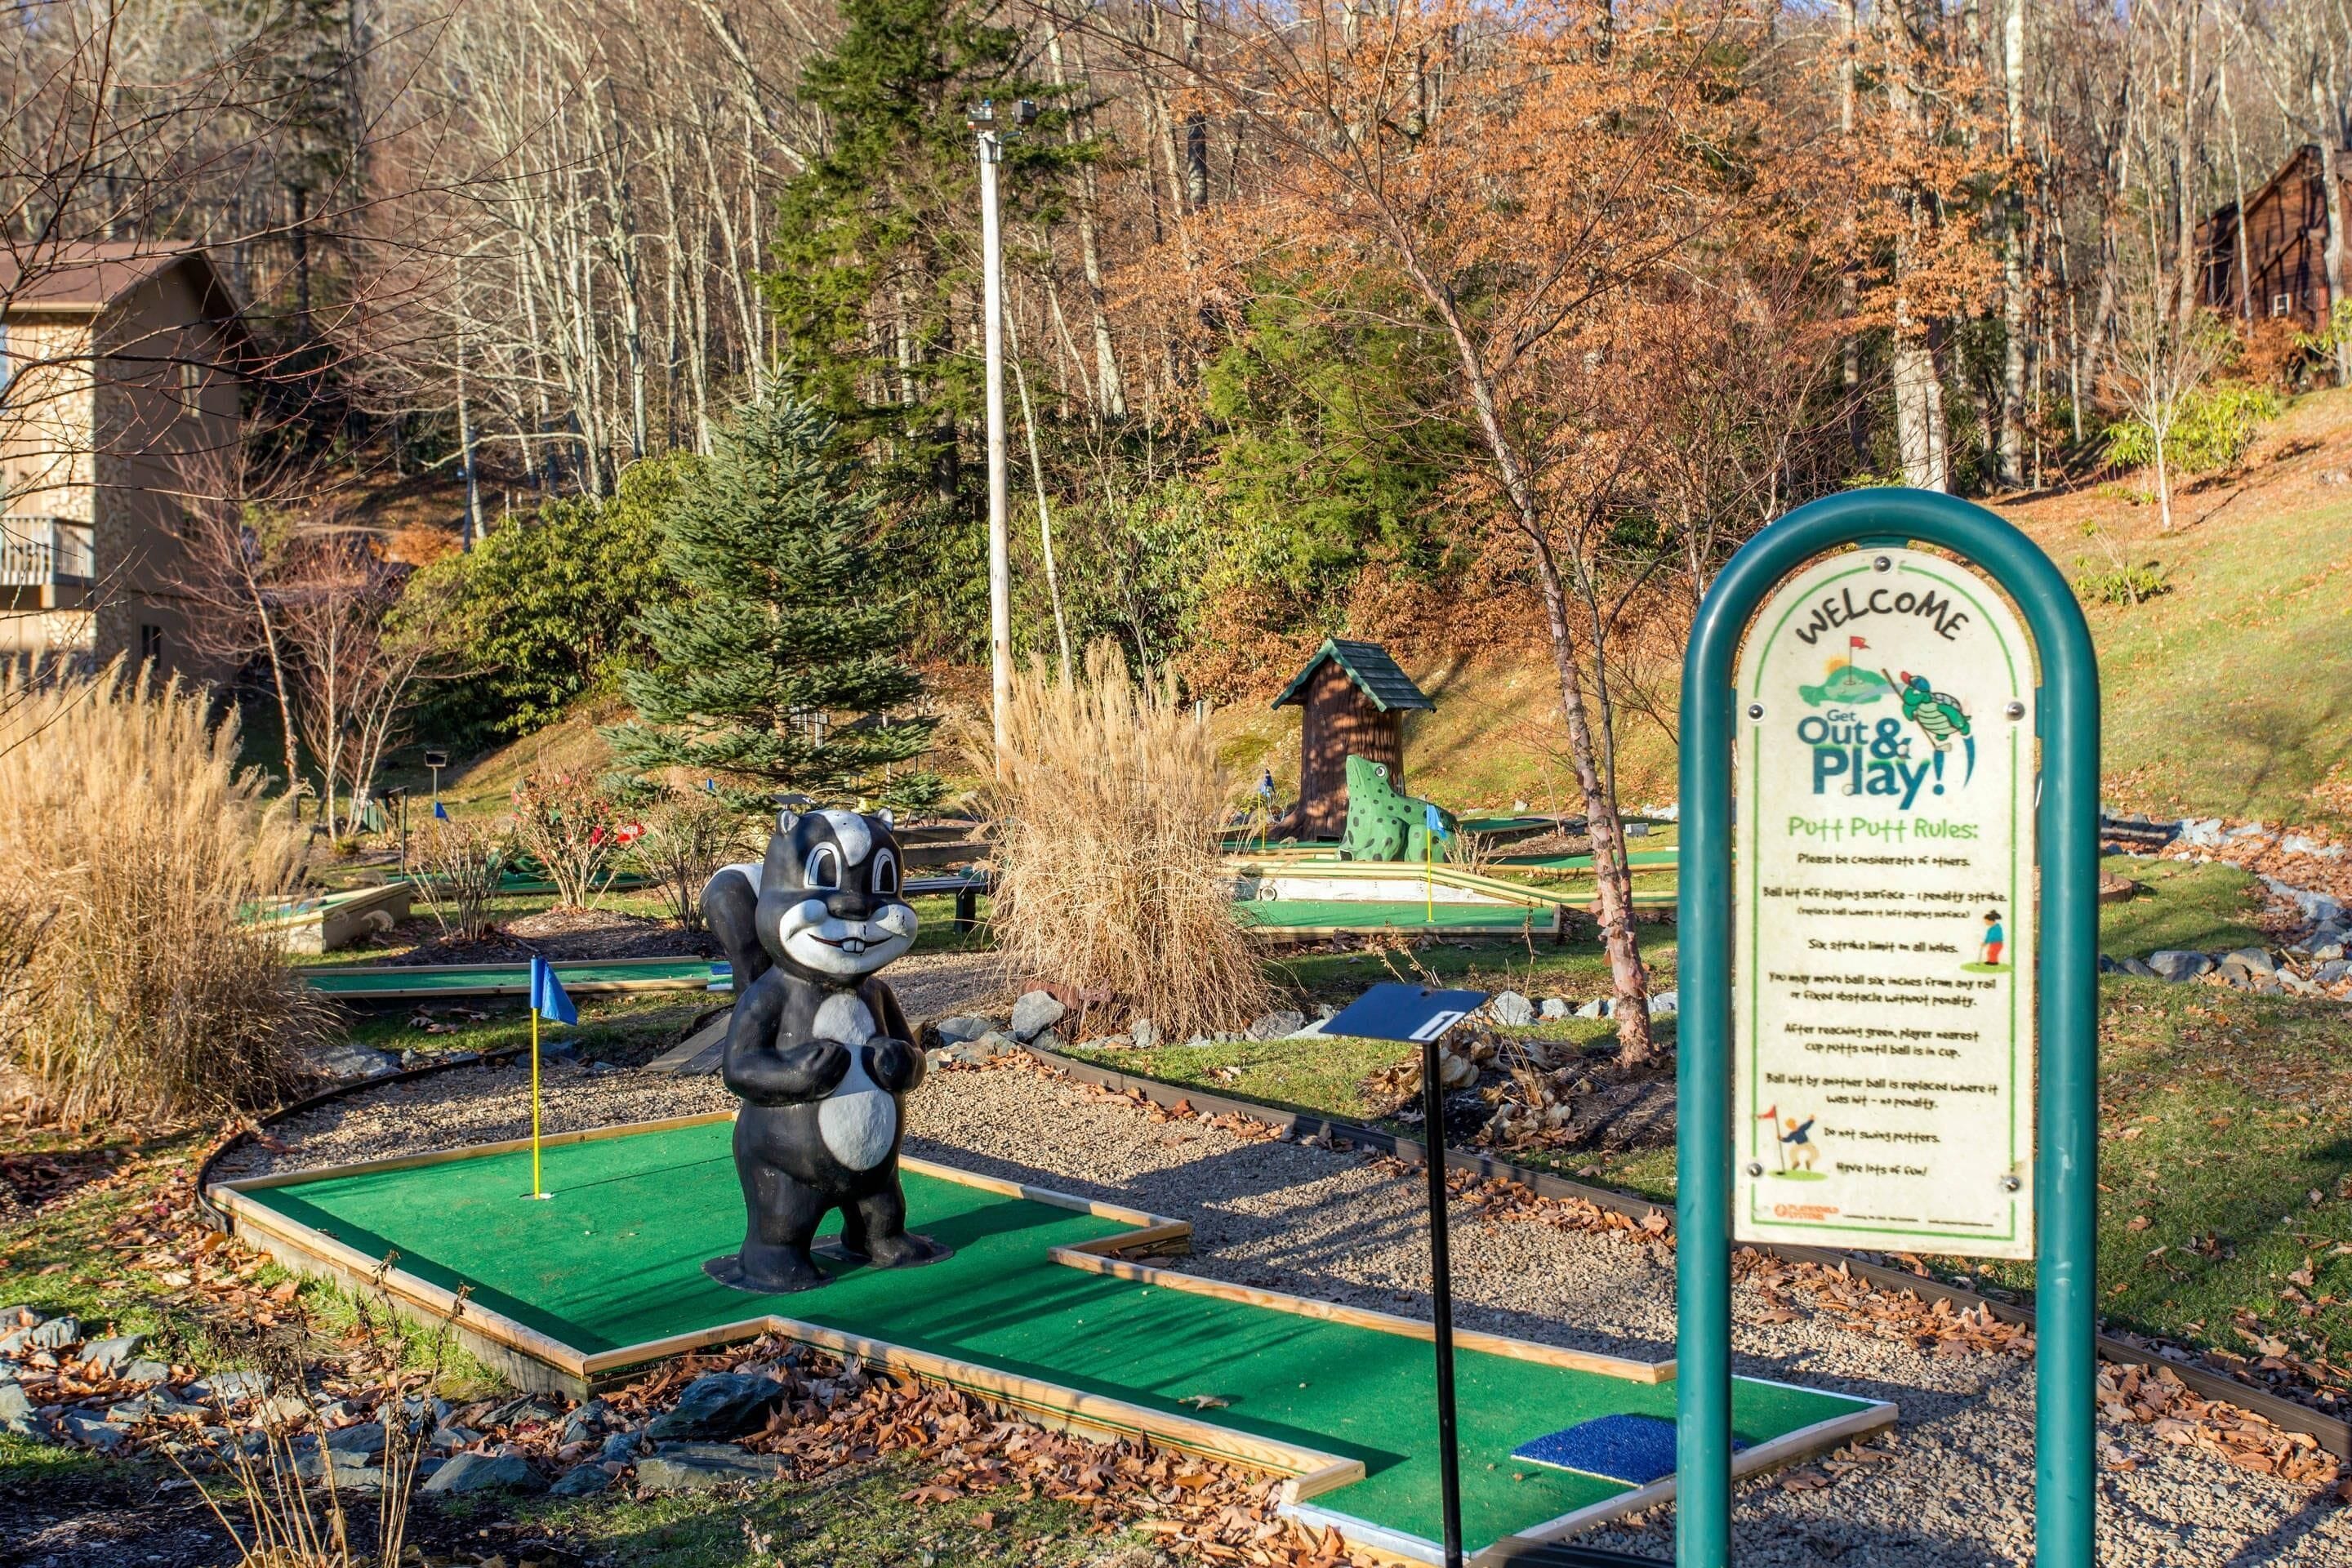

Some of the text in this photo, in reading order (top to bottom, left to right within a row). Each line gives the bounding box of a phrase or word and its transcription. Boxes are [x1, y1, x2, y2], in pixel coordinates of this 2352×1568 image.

[1796, 588, 1969, 644] WELCOME
[1827, 709, 1856, 722] Get
[1797, 716, 1912, 760] Out &
[1813, 746, 1945, 810] Play!
[1788, 816, 1980, 843] Putt Putt Rules:
[1797, 853, 1971, 868] Please be considerate of others.
[1762, 887, 1782, 897] Ball
[1784, 888, 1801, 899] hit
[1803, 889, 1821, 897] off
[1824, 889, 1860, 901] playing
[1862, 889, 1905, 900] surface
[1923, 891, 1965, 903] penalty
[1967, 891, 2007, 904] stroke.
[1797, 906, 1830, 916] (replace
[1833, 907, 1846, 915] ball
[1876, 908, 1883, 918] it
[1885, 908, 1902, 918] left
[1904, 909, 1932, 920] playing
[1934, 910, 1970, 919] surface)
[1808, 938, 1958, 953] Six stroke limit on all holes.
[1769, 972, 1997, 990] You may move ball six inches from any rail
[1803, 990, 1833, 1001] fixed
[1836, 991, 1882, 1004] obstacle
[1885, 994, 1930, 1006] without
[1932, 996, 1978, 1008] penalty.
[1422, 1013, 1457, 1039] 1
[1784, 1023, 1980, 1042] After reaching green, player nearest
[1805, 1042, 1962, 1059] cup putts until ball is in cup.
[1766, 1072, 1998, 1096] Ball hit by another ball is replaced where it
[1826, 1094, 1850, 1104] was
[1851, 1095, 1868, 1107] hit
[1894, 1098, 1939, 1111] penalty.
[1824, 1127, 1941, 1145] Do not swing putters.
[1836, 1161, 1928, 1177] Have lots of fun!
